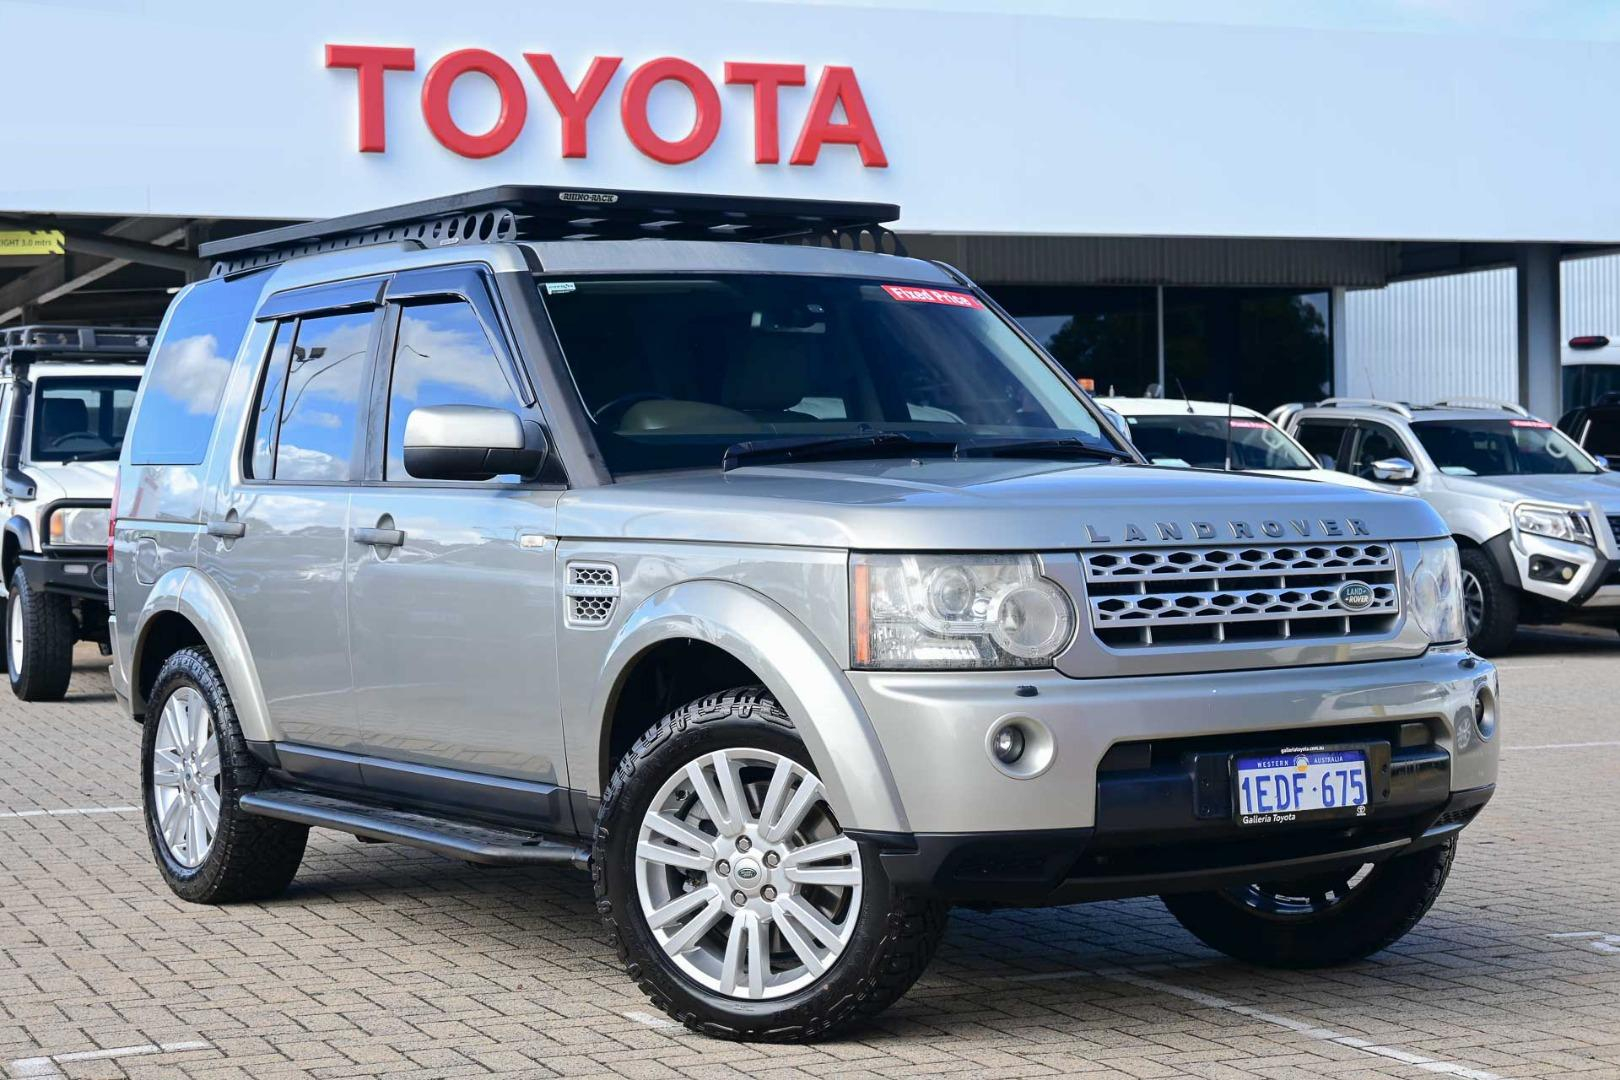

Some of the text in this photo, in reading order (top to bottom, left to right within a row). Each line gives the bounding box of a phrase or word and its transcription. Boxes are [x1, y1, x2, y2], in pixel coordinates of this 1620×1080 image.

[324, 43, 888, 168] TOYOTA
[889, 287, 972, 306] Fixed Price
[1257, 756, 1343, 768] WESTERN AUSTRALIA
[1243, 813, 1296, 824] Galleria Toyota
